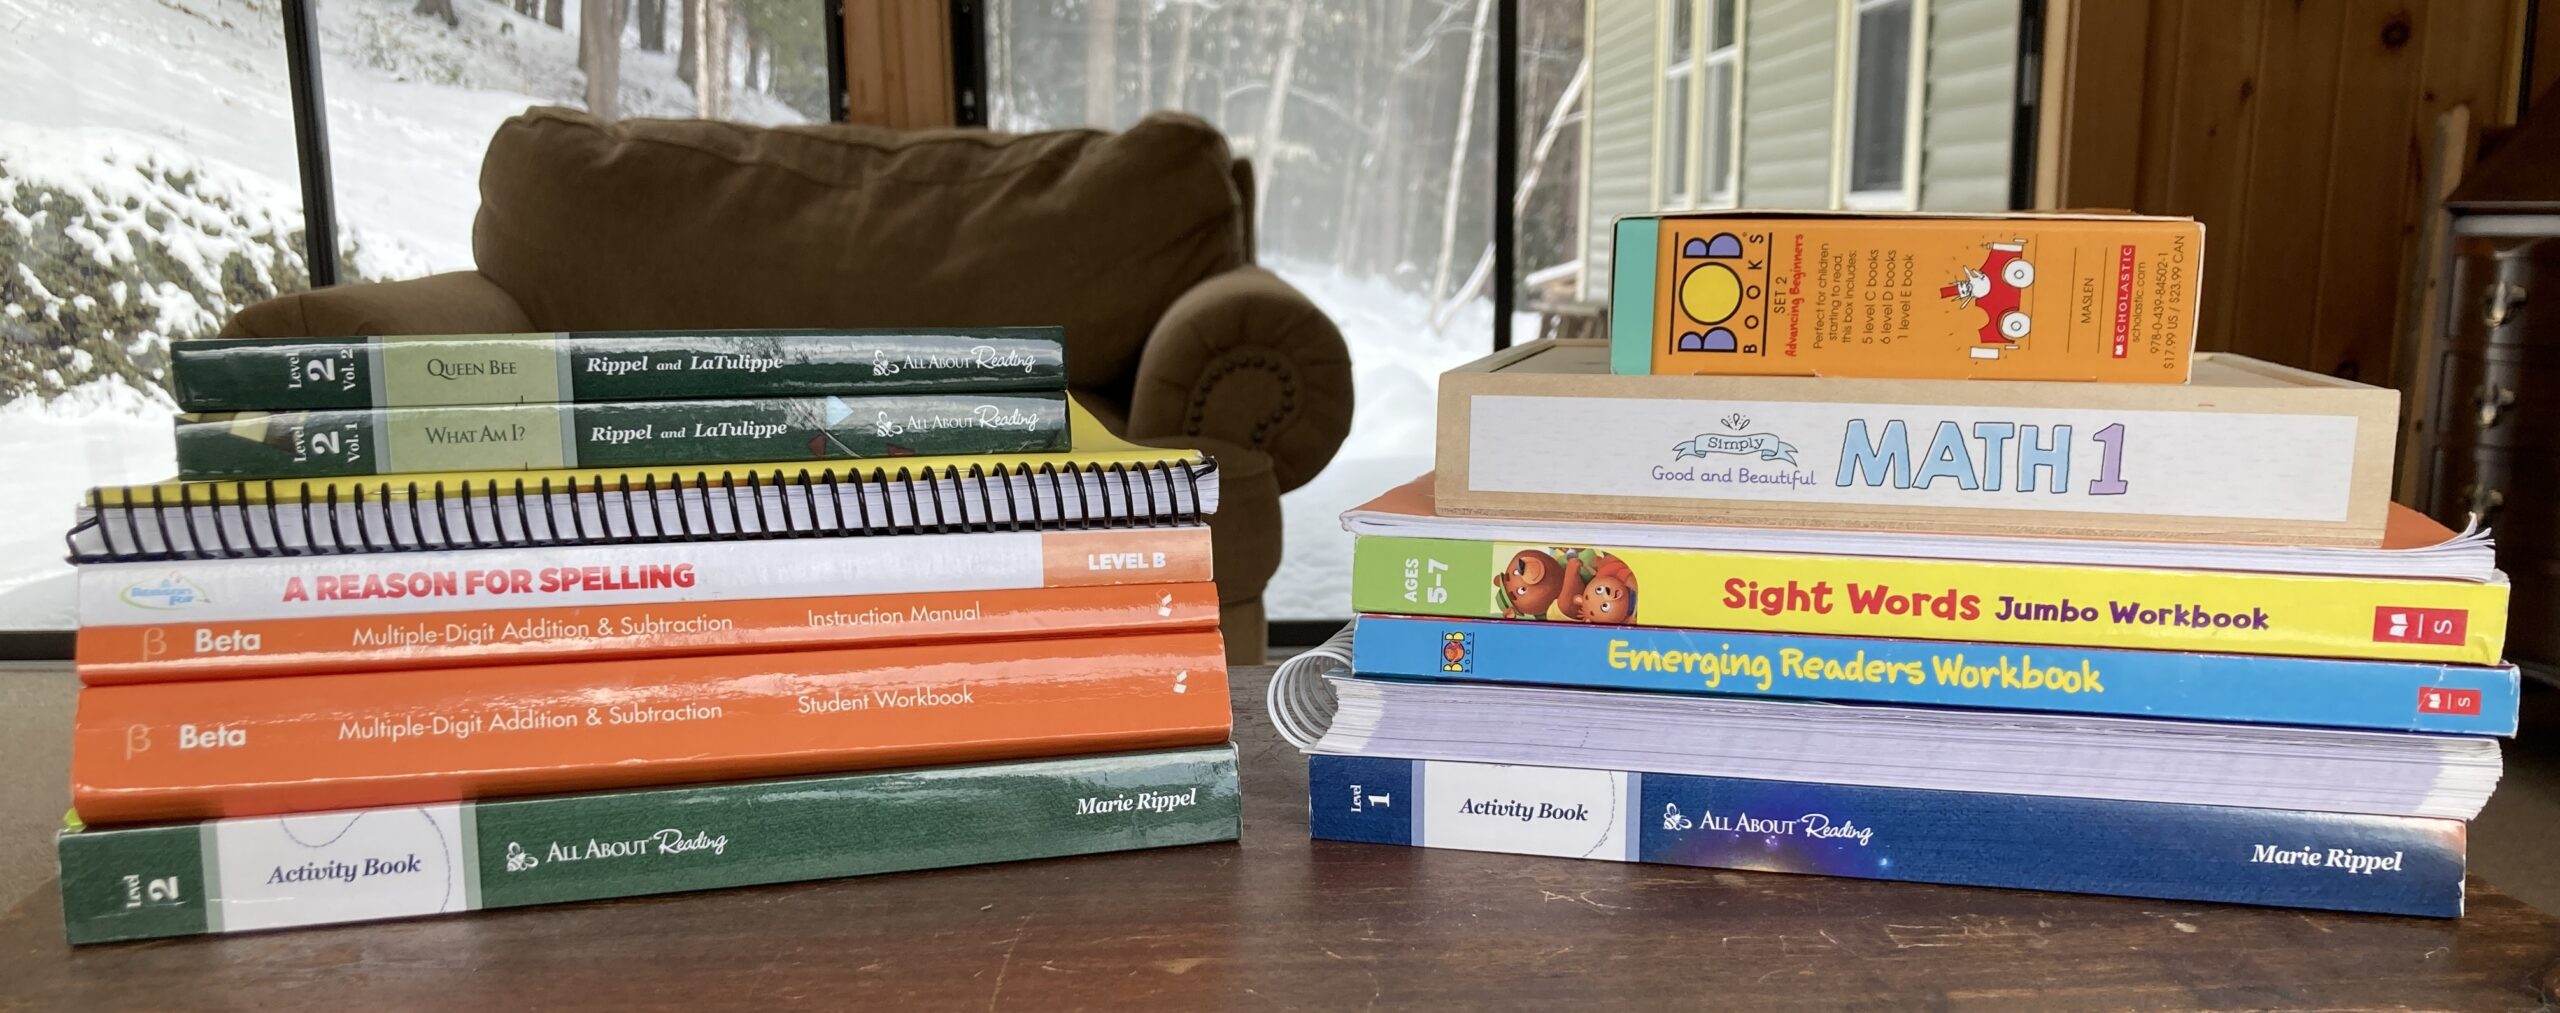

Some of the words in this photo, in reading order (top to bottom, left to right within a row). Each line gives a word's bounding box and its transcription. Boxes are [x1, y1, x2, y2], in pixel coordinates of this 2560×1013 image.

[2173, 235, 2185, 264] CAN
[1789, 234, 1806, 296] Beginners
[1817, 243, 1829, 288] children
[1866, 249, 1879, 287] books
[1884, 249, 1896, 287] books
[1902, 254, 1914, 286] book
[1677, 232, 1743, 353] BOB
[1743, 234, 1764, 353] BOOKS
[1776, 276, 1787, 285] 2
[1830, 285, 1840, 297] to
[2116, 247, 2133, 342] SCHOLASTIC
[2169, 265, 2182, 304] $23.99
[1774, 290, 1786, 314] SET
[1816, 291, 1826, 305] for
[1865, 291, 1876, 301] C
[1883, 291, 1894, 301] D
[2081, 278, 2094, 324] MASLEN
[2132, 262, 2146, 343] scholastic.com
[2150, 252, 2169, 354] 978-0-439-84502-1
[1829, 300, 1842, 341] starting
[1843, 302, 1853, 323] box
[1863, 304, 1875, 333] level
[1881, 304, 1893, 333] level
[1899, 300, 1911, 330] level
[2167, 314, 2178, 330] US
[1785, 298, 1804, 357] Advancing
[1813, 308, 1825, 349] Perfect
[1842, 325, 1852, 343] this
[1862, 337, 1873, 345] 5
[1880, 337, 1891, 345] 6
[343, 348, 355, 360] 2
[586, 355, 648, 375] Rippel
[656, 359, 682, 371] and
[690, 354, 783, 374] LaTulippe
[971, 345, 1036, 372] Reading
[2164, 331, 2176, 369] $17.99
[288, 352, 300, 389] Level
[306, 358, 336, 382] 2
[342, 362, 357, 391] Vol.
[512, 425, 526, 441] I?
[591, 424, 652, 445] Rippel
[660, 427, 686, 439] and
[694, 421, 787, 442] LaTulippe
[974, 405, 1039, 433] Reading
[294, 426, 306, 463] Level
[311, 431, 340, 455] 2
[347, 433, 361, 463] Vol.
[1707, 435, 1765, 454] Simply
[1835, 419, 2072, 494] MATH
[2089, 422, 2128, 495] 1
[1652, 465, 1695, 484] Good
[1701, 468, 1733, 484] and
[1739, 467, 1817, 490] Beautiful
[1088, 552, 1149, 571] LEVEL
[1152, 552, 1167, 568] B
[282, 576, 310, 602] A
[317, 571, 457, 601] REASON
[466, 569, 533, 596] FOR
[539, 563, 695, 593] SPELLING
[1404, 558, 1419, 603] AGES
[808, 607, 904, 627] Instruction
[910, 600, 980, 624] Manual
[1722, 577, 1833, 616] Sight
[1847, 582, 1981, 621] Words
[1994, 595, 2099, 623] Jumbo
[2109, 601, 2270, 630] Workbook
[195, 628, 261, 653] Beta
[353, 622, 496, 646] Multiple-Digit
[501, 618, 590, 641] Addition
[598, 618, 614, 636] &
[621, 613, 733, 634] Subtraction
[1443, 631, 1465, 672] BOB
[1607, 638, 1773, 691] Emerging
[1779, 647, 1925, 685] Readers
[1932, 653, 2104, 694] Workbook
[798, 693, 869, 714] Student
[874, 684, 974, 709] Workbook
[179, 724, 247, 750] Beta
[338, 712, 484, 743] Multiple-Digit
[488, 708, 578, 732] Addition
[585, 708, 602, 726] &
[609, 704, 722, 725] Subtraction
[1076, 794, 1133, 815] Marie
[1136, 787, 1196, 812] Rippel
[1350, 784, 1363, 814] Level
[1370, 792, 1391, 809] 1
[1459, 797, 1534, 822] Activity
[1537, 800, 1588, 822] Book
[653, 829, 727, 856] Reading
[1801, 813, 1873, 845] Reading
[266, 860, 358, 886] Activity
[362, 854, 421, 877] Book
[2251, 844, 2321, 867] Marie
[2324, 848, 2403, 875] Rippel
[126, 875, 141, 908] Level
[148, 876, 179, 900] 2
